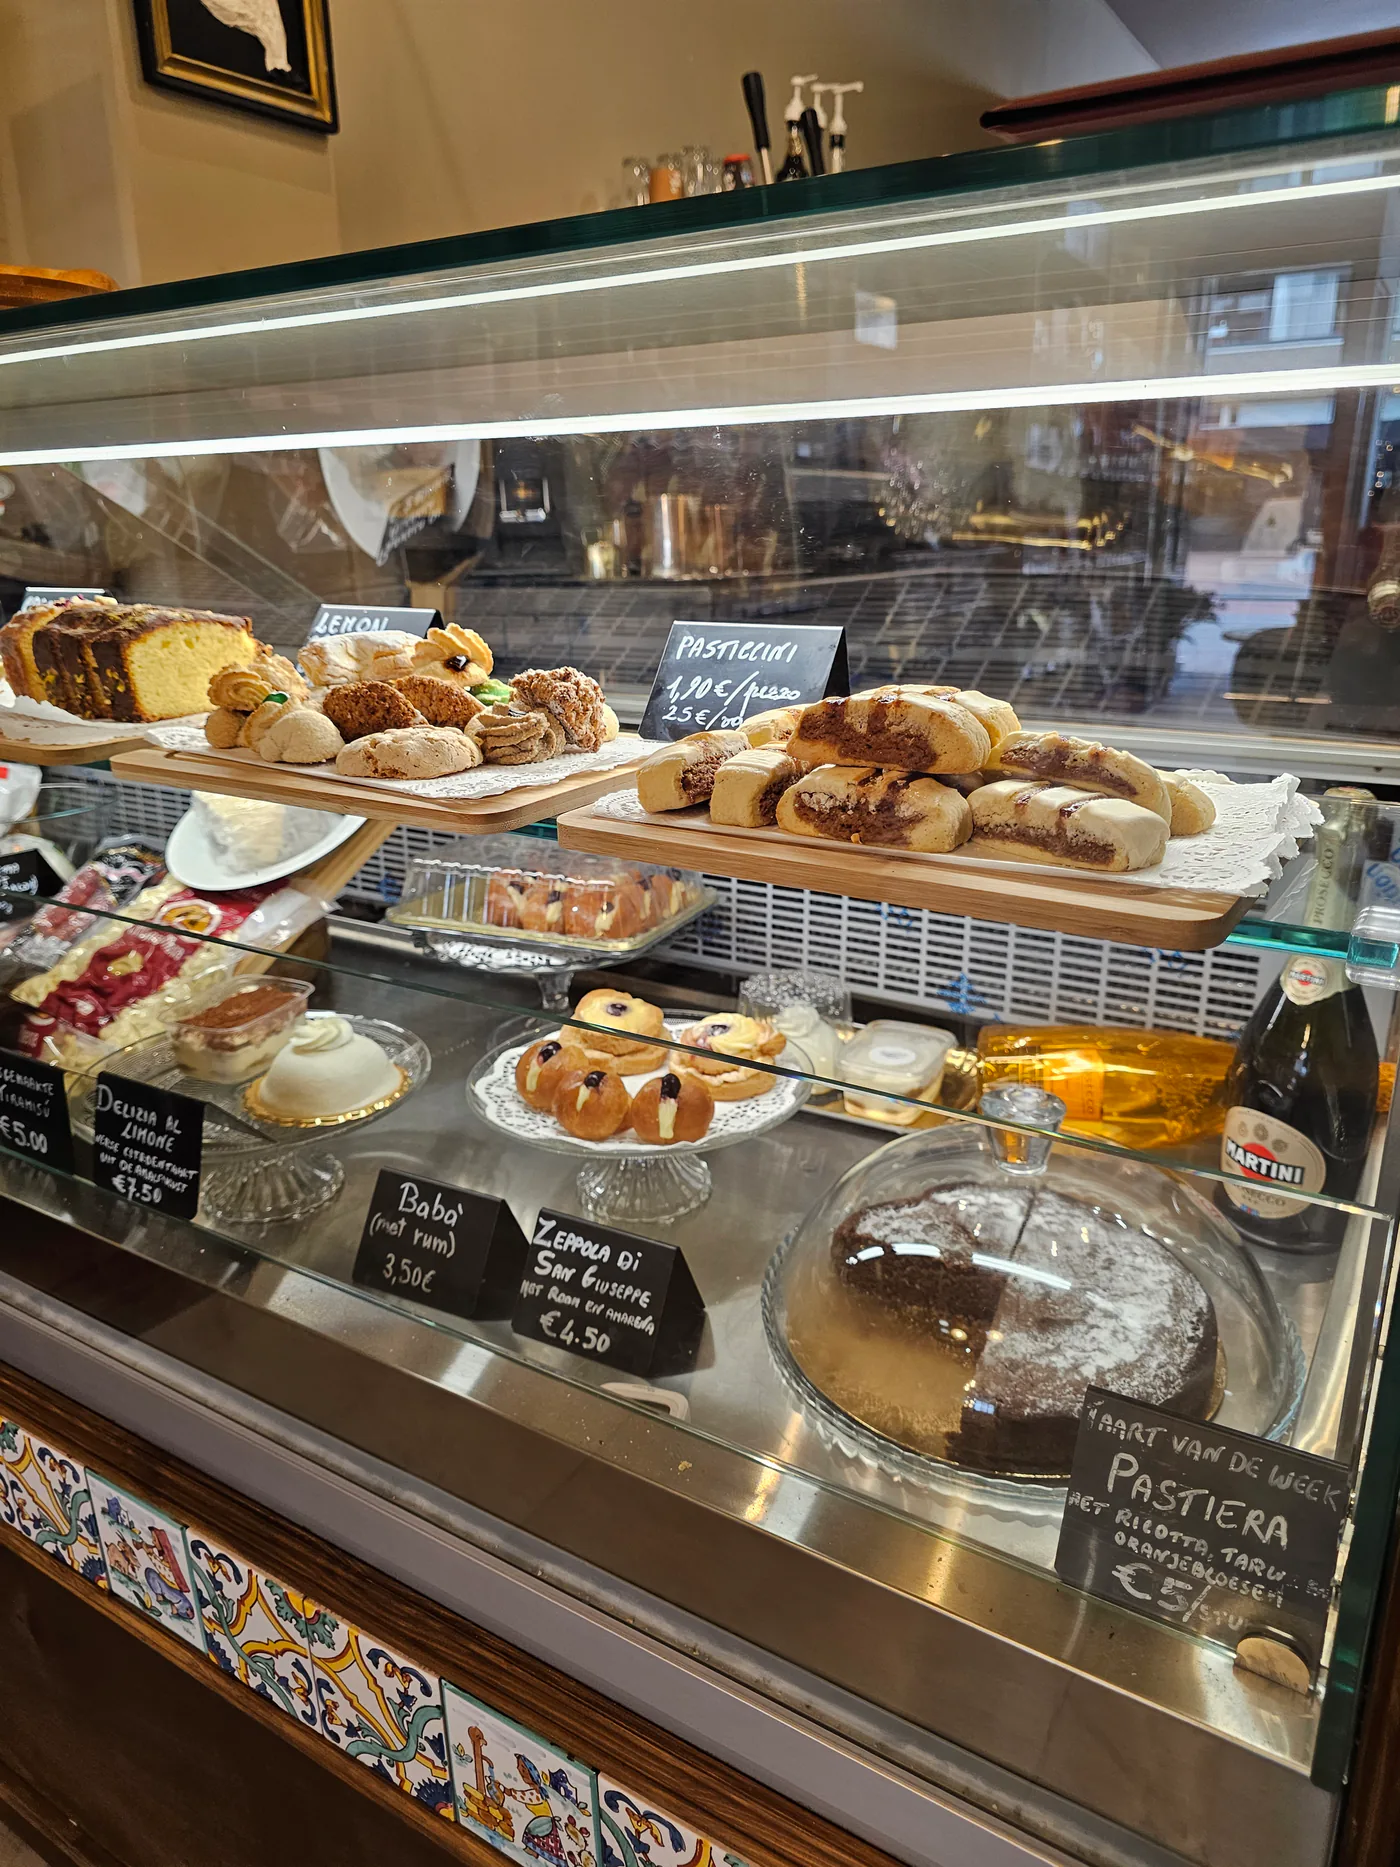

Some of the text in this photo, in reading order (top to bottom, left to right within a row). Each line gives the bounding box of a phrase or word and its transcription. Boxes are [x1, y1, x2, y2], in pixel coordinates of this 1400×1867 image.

[315, 612, 389, 634] LEMON
[675, 635, 798, 662] PASTICCINI
[97, 1083, 182, 1135] DELIZIA AL
[0, 1115, 48, 1154] €5.00
[120, 1121, 175, 1152] LIMONE
[1226, 1137, 1303, 1184] MARTINI
[111, 1174, 162, 1203] €7.50
[398, 1181, 464, 1227] Babà
[369, 1212, 456, 1259] (met rum)
[532, 1216, 611, 1263] ZEPPOLA
[382, 1252, 436, 1293] 3,50€
[539, 1310, 611, 1353] €4.50
[1172, 1434, 1226, 1463] VAN
[1228, 1451, 1264, 1479] DE
[1268, 1464, 1343, 1512] WEEK
[1107, 1452, 1288, 1551] PASTIERA
[1220, 1547, 1296, 1588] TARW
